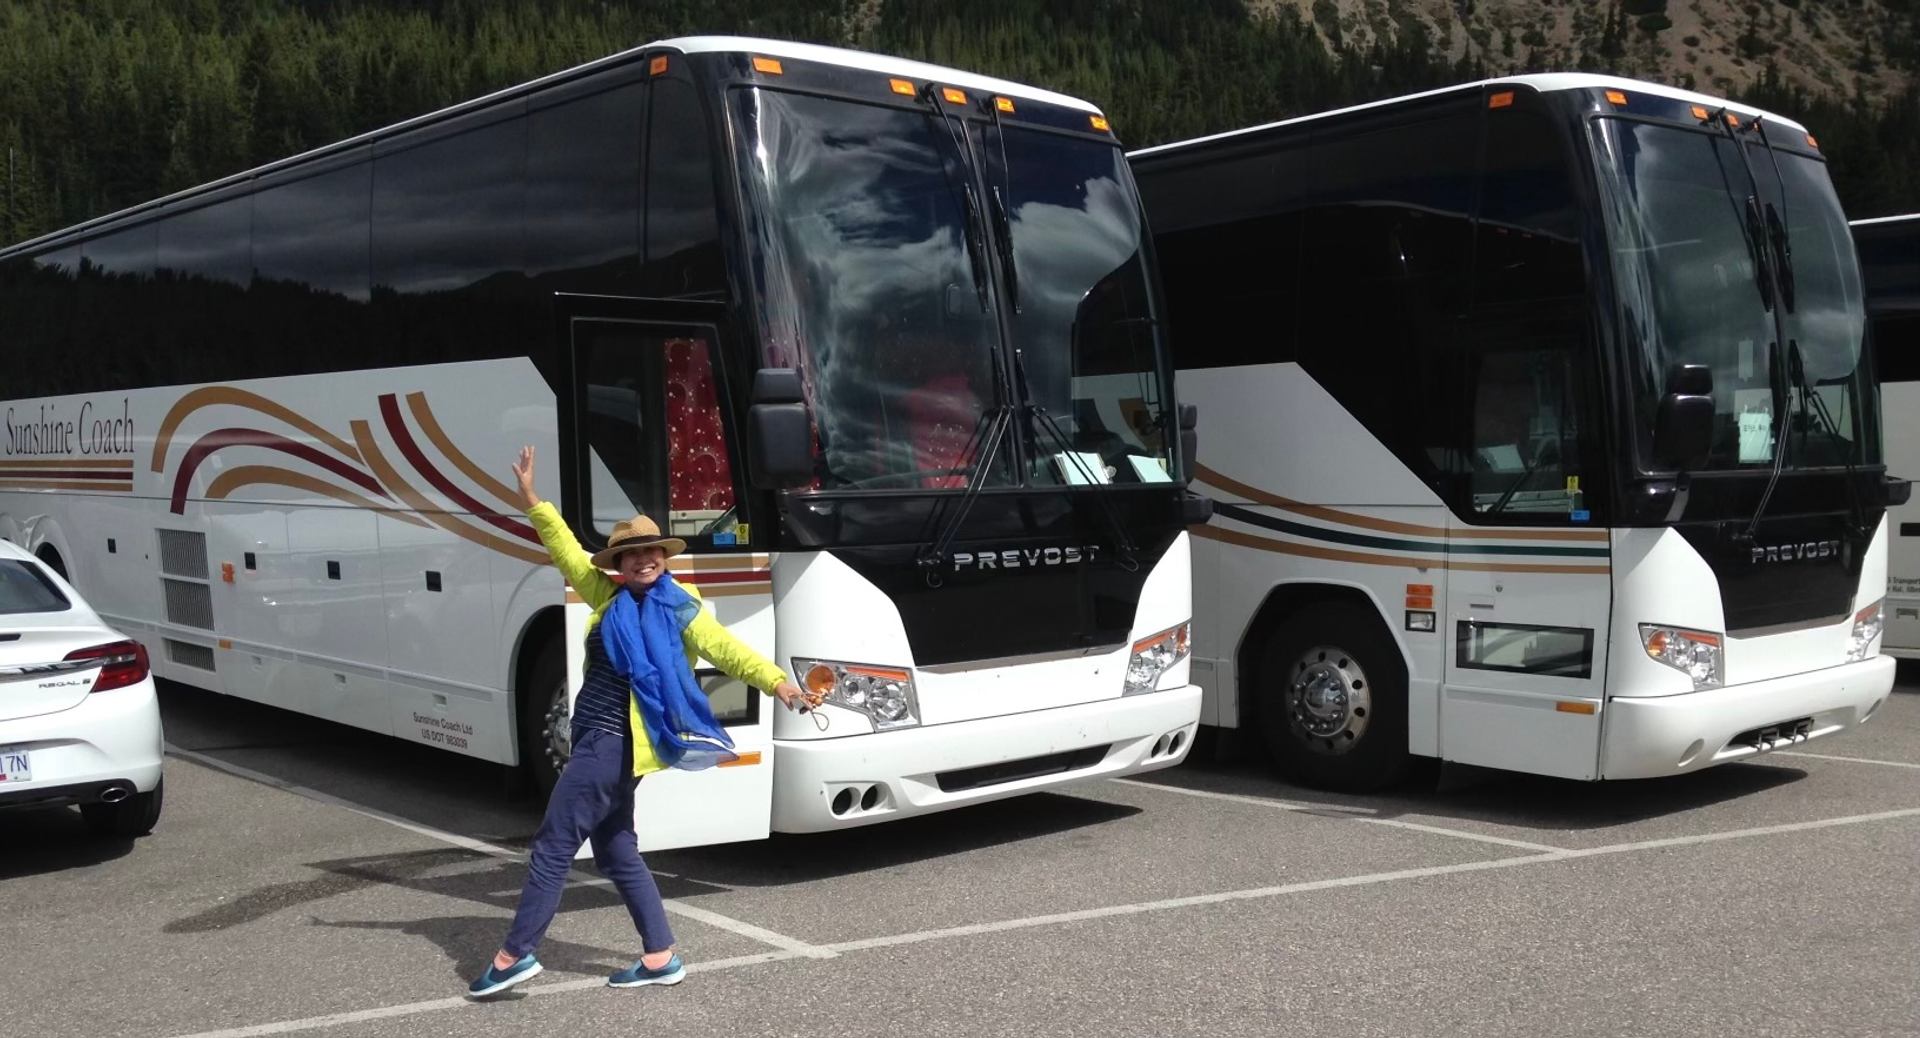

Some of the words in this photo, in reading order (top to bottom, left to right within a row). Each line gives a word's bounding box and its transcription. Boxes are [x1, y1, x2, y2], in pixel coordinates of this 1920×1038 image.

[6, 404, 74, 455] Sunshine
[78, 397, 135, 455] Coach
[953, 545, 1100, 571] PREVOST
[1752, 540, 1840, 564] PREVOST
[38, 681, 80, 689] REGAL
[413, 712, 440, 727] Sunshine
[440, 718, 461, 732] Coach
[461, 723, 473, 735] Ltd
[421, 729, 431, 740] US
[431, 731, 444, 742] DOT
